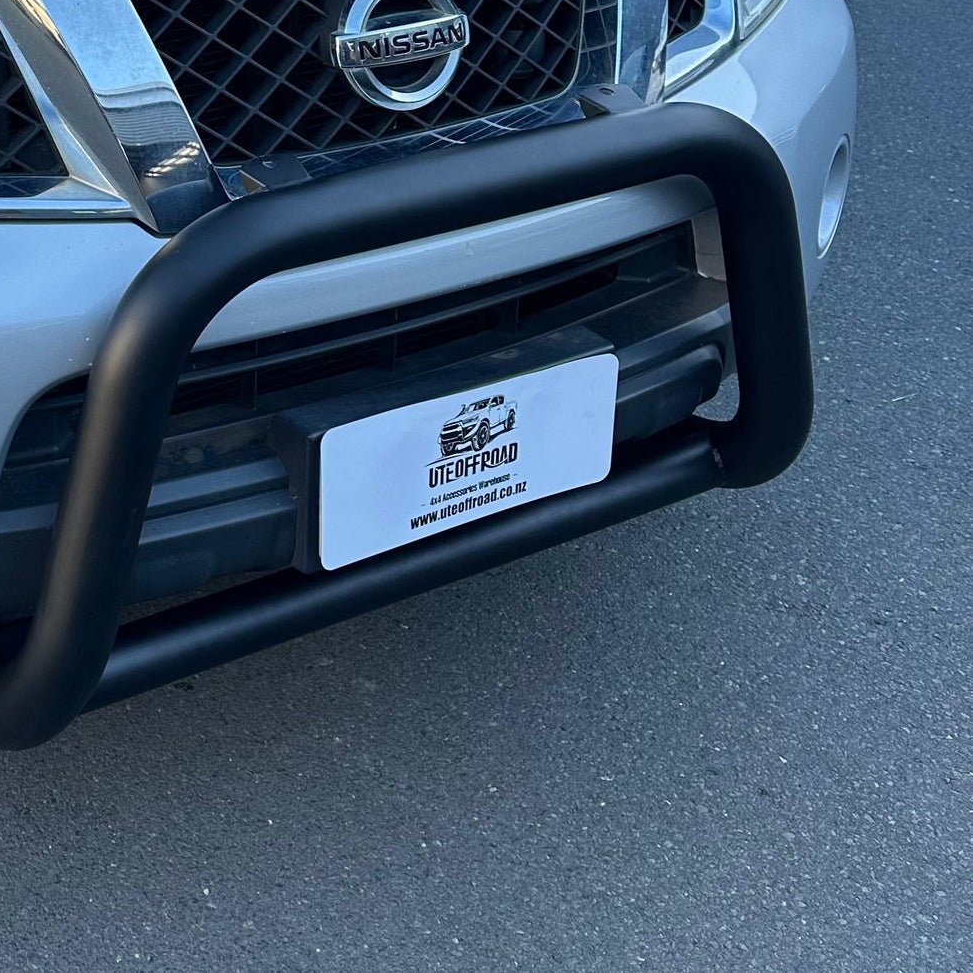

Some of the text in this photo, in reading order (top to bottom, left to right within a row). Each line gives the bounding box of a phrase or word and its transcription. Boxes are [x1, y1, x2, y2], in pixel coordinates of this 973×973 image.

[358, 21, 465, 61] NISSAN
[429, 442, 518, 488] UTEOFFROAD
[411, 481, 527, 529] www.uteoffroad.co.nz
[430, 474, 510, 506] 4x4 Accessories Warehouse
